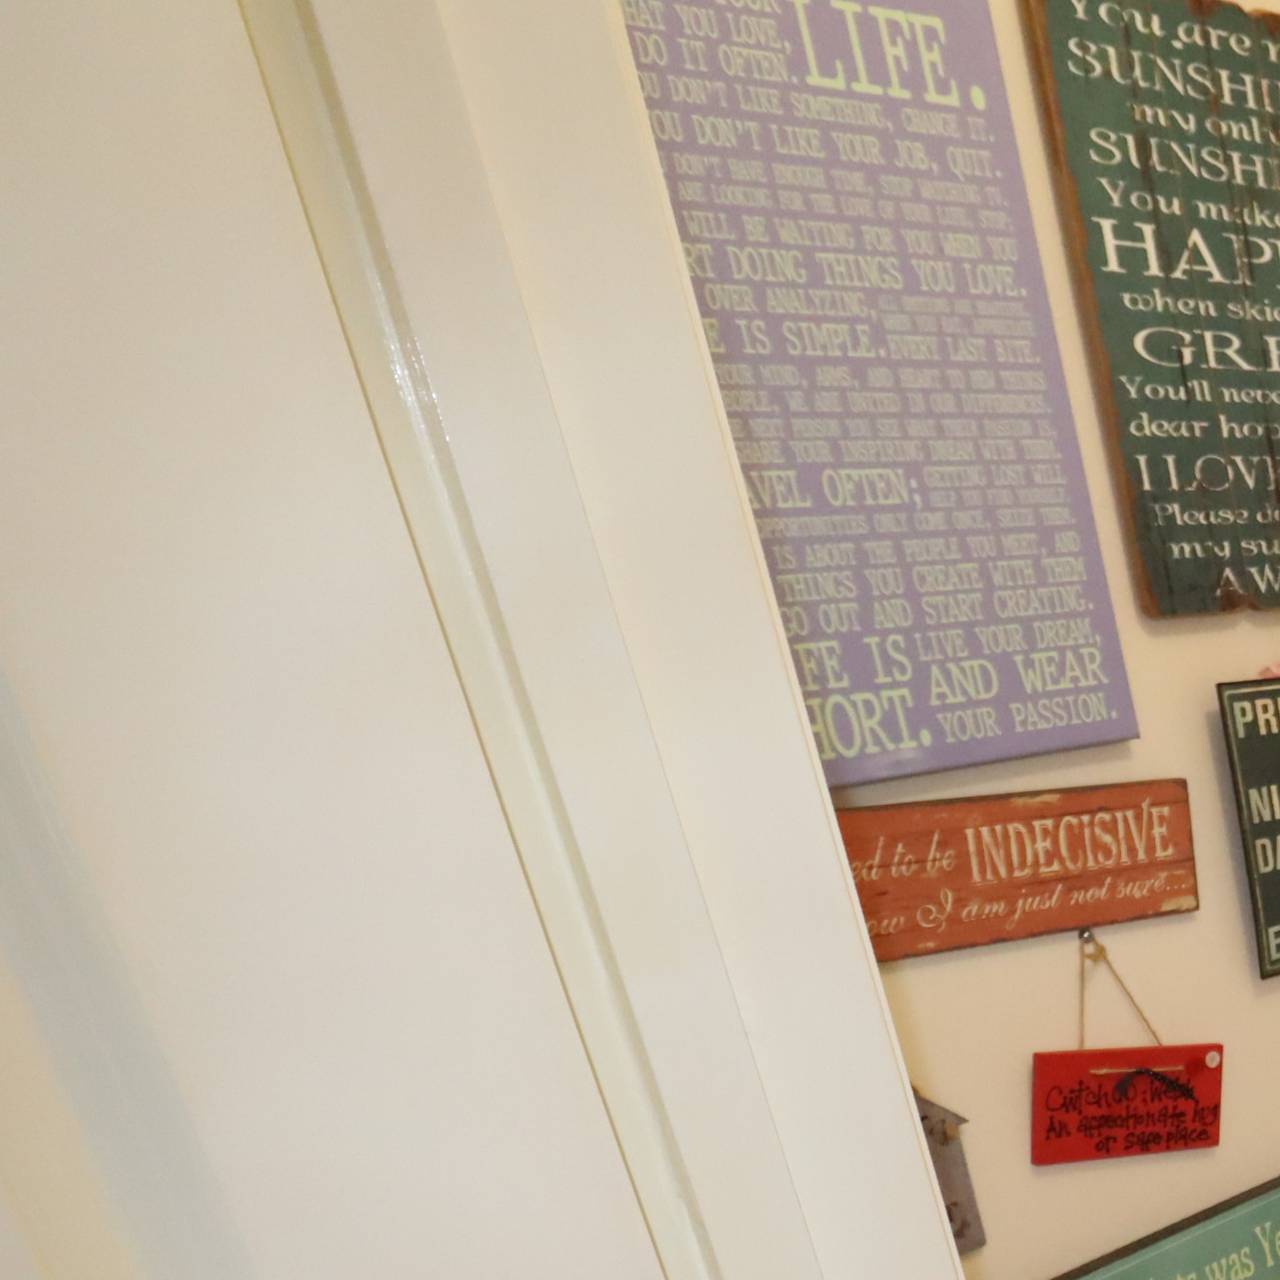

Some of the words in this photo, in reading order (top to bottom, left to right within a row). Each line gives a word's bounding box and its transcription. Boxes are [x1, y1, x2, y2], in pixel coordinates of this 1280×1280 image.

[625, 0, 665, 28] HAT
[674, 6, 719, 37] YOU
[728, 14, 792, 52] LOVE,
[1068, 0, 1165, 37] You
[1173, 21, 1251, 56] are
[635, 32, 666, 64] DO
[679, 39, 708, 70] IT
[720, 45, 798, 82] OFTEN.
[795, 0, 986, 109] LIFE.
[669, 77, 727, 106] DON'T
[737, 85, 783, 113] LIKE
[1128, 101, 1197, 136] my
[653, 111, 683, 141] OU
[692, 116, 760, 149] DON'T
[771, 126, 825, 157] LIKE
[832, 134, 886, 163] YOUR
[896, 141, 938, 173] JOB,
[949, 147, 1002, 180] QUIT.
[1096, 176, 1183, 217] You
[684, 212, 735, 237] WILL
[774, 220, 854, 248] WAITING
[903, 232, 936, 253] YOU
[988, 238, 1018, 260] YOU
[728, 248, 806, 281] DOING
[817, 254, 903, 287] THINGS
[913, 260, 954, 291] YOU
[965, 265, 1026, 294] LOVE.
[706, 285, 759, 311] OVER
[767, 288, 878, 321] ANALYZING,
[1121, 288, 1218, 317] when
[737, 321, 771, 353] IS
[784, 323, 886, 356] SIMPLE.
[1118, 374, 1213, 403] You'll
[1128, 412, 1209, 438] dear
[823, 469, 922, 508] OFTEN;
[1135, 454, 1152, 491] I
[1152, 501, 1250, 527] Please
[807, 545, 856, 566] ABOUT
[1170, 538, 1231, 560] my
[779, 573, 856, 600] THINGS
[865, 570, 904, 594] YOU
[914, 565, 982, 590] CREATE
[990, 562, 1035, 584] WITH
[1042, 558, 1086, 580] THEM
[821, 604, 861, 632] OUT
[876, 601, 912, 627] AND
[923, 594, 983, 622] START
[995, 587, 1093, 616] CREATING.
[916, 631, 968, 659] LIVE
[976, 626, 1027, 652] YOUR
[1035, 620, 1099, 647] DREAM,
[795, 642, 848, 689] FE
[865, 636, 912, 682] IS
[930, 661, 998, 704] AND
[1015, 649, 1109, 692] WEAR
[808, 689, 932, 758] HORT.
[938, 709, 1001, 741] YOUR
[1010, 694, 1118, 731] PASSION.
[852, 836, 884, 881] ed
[891, 842, 918, 878] to
[925, 829, 957, 877] be
[964, 797, 1174, 885] INDECISIVE
[868, 916, 905, 935] ow
[916, 887, 954, 934] I
[961, 902, 1008, 923] am
[1007, 883, 1063, 931] just
[1069, 877, 1110, 906] not
[1116, 872, 1190, 900] sure...
[1166, 1127, 1211, 1149] place
